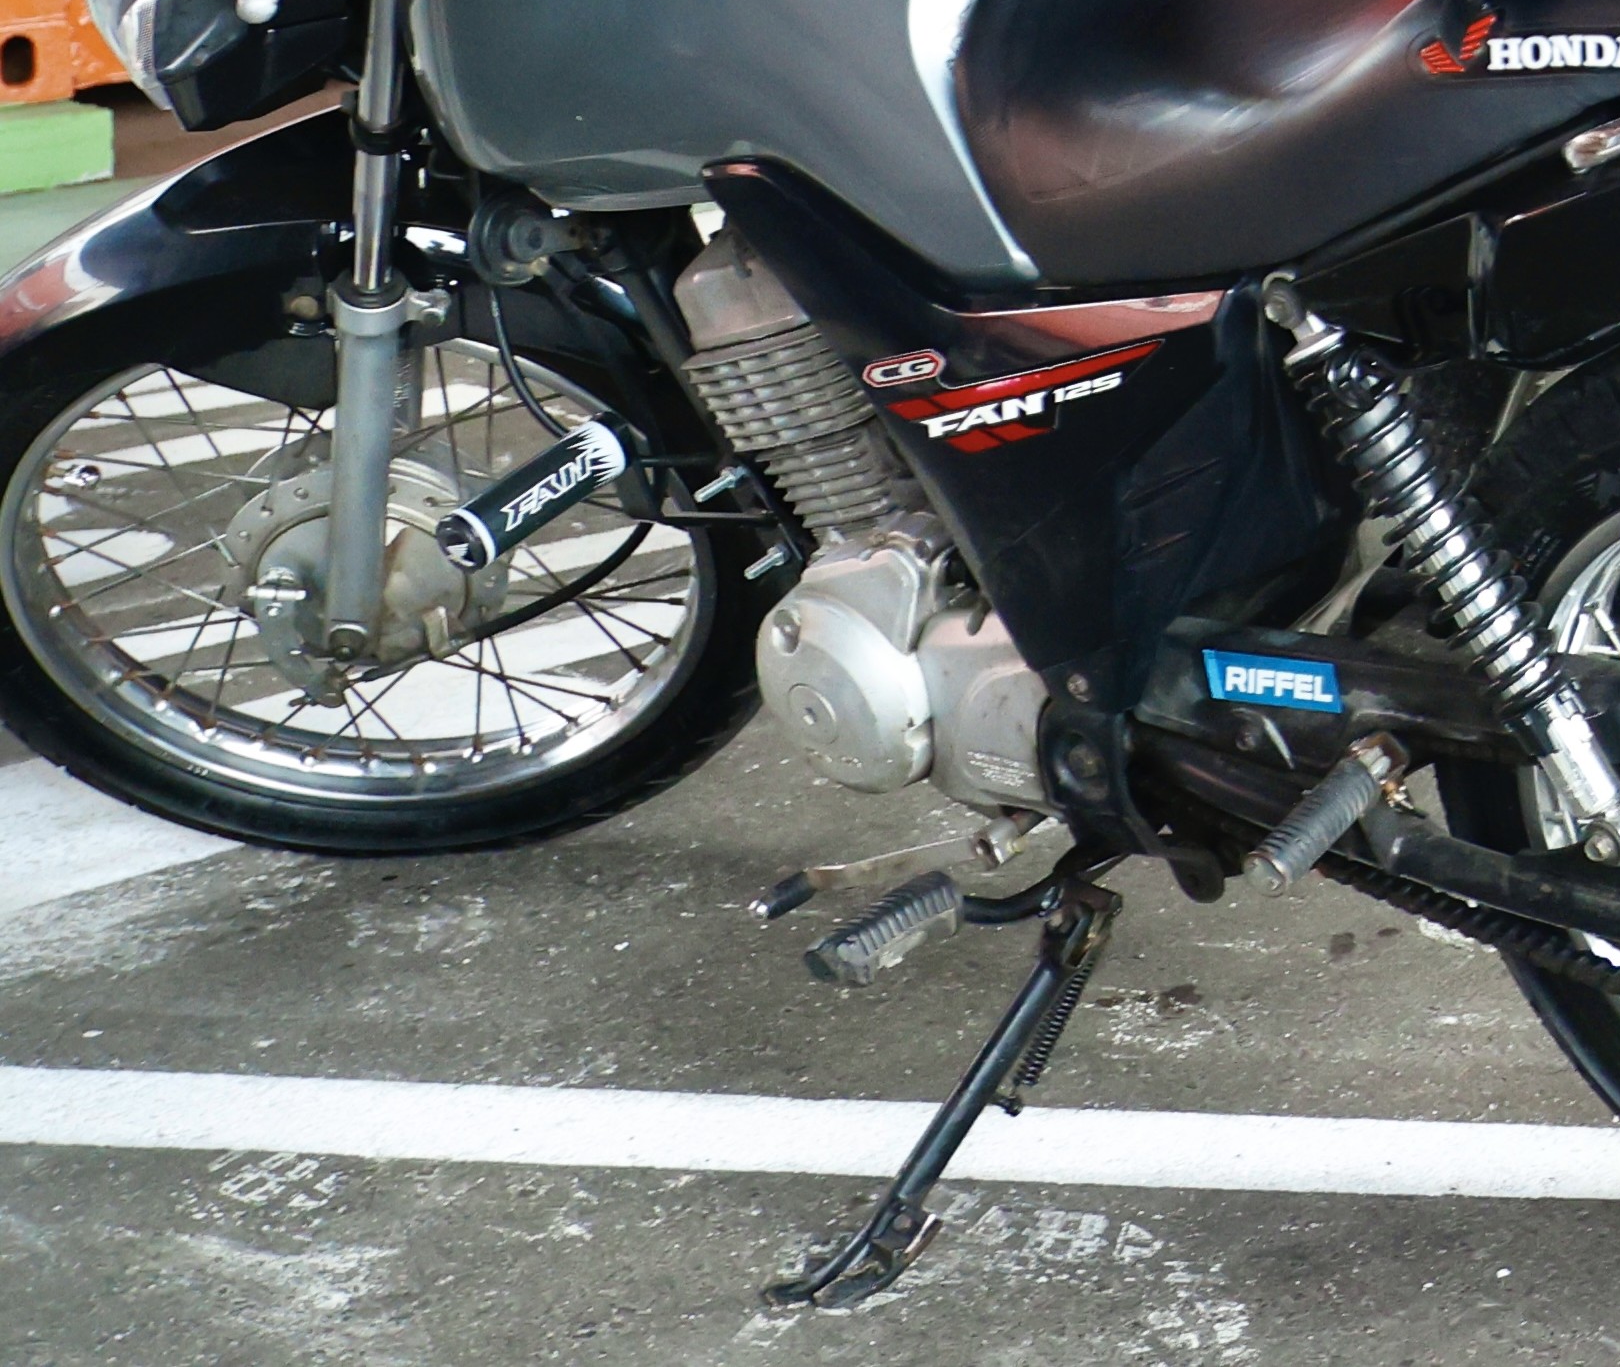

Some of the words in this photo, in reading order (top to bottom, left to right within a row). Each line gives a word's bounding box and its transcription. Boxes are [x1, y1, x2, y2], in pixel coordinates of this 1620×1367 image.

[869, 358, 937, 383] CG
[920, 391, 1050, 439] FAN
[1052, 371, 1123, 404] 125
[500, 446, 599, 533] FAN
[1225, 665, 1334, 703] RIFFEL
